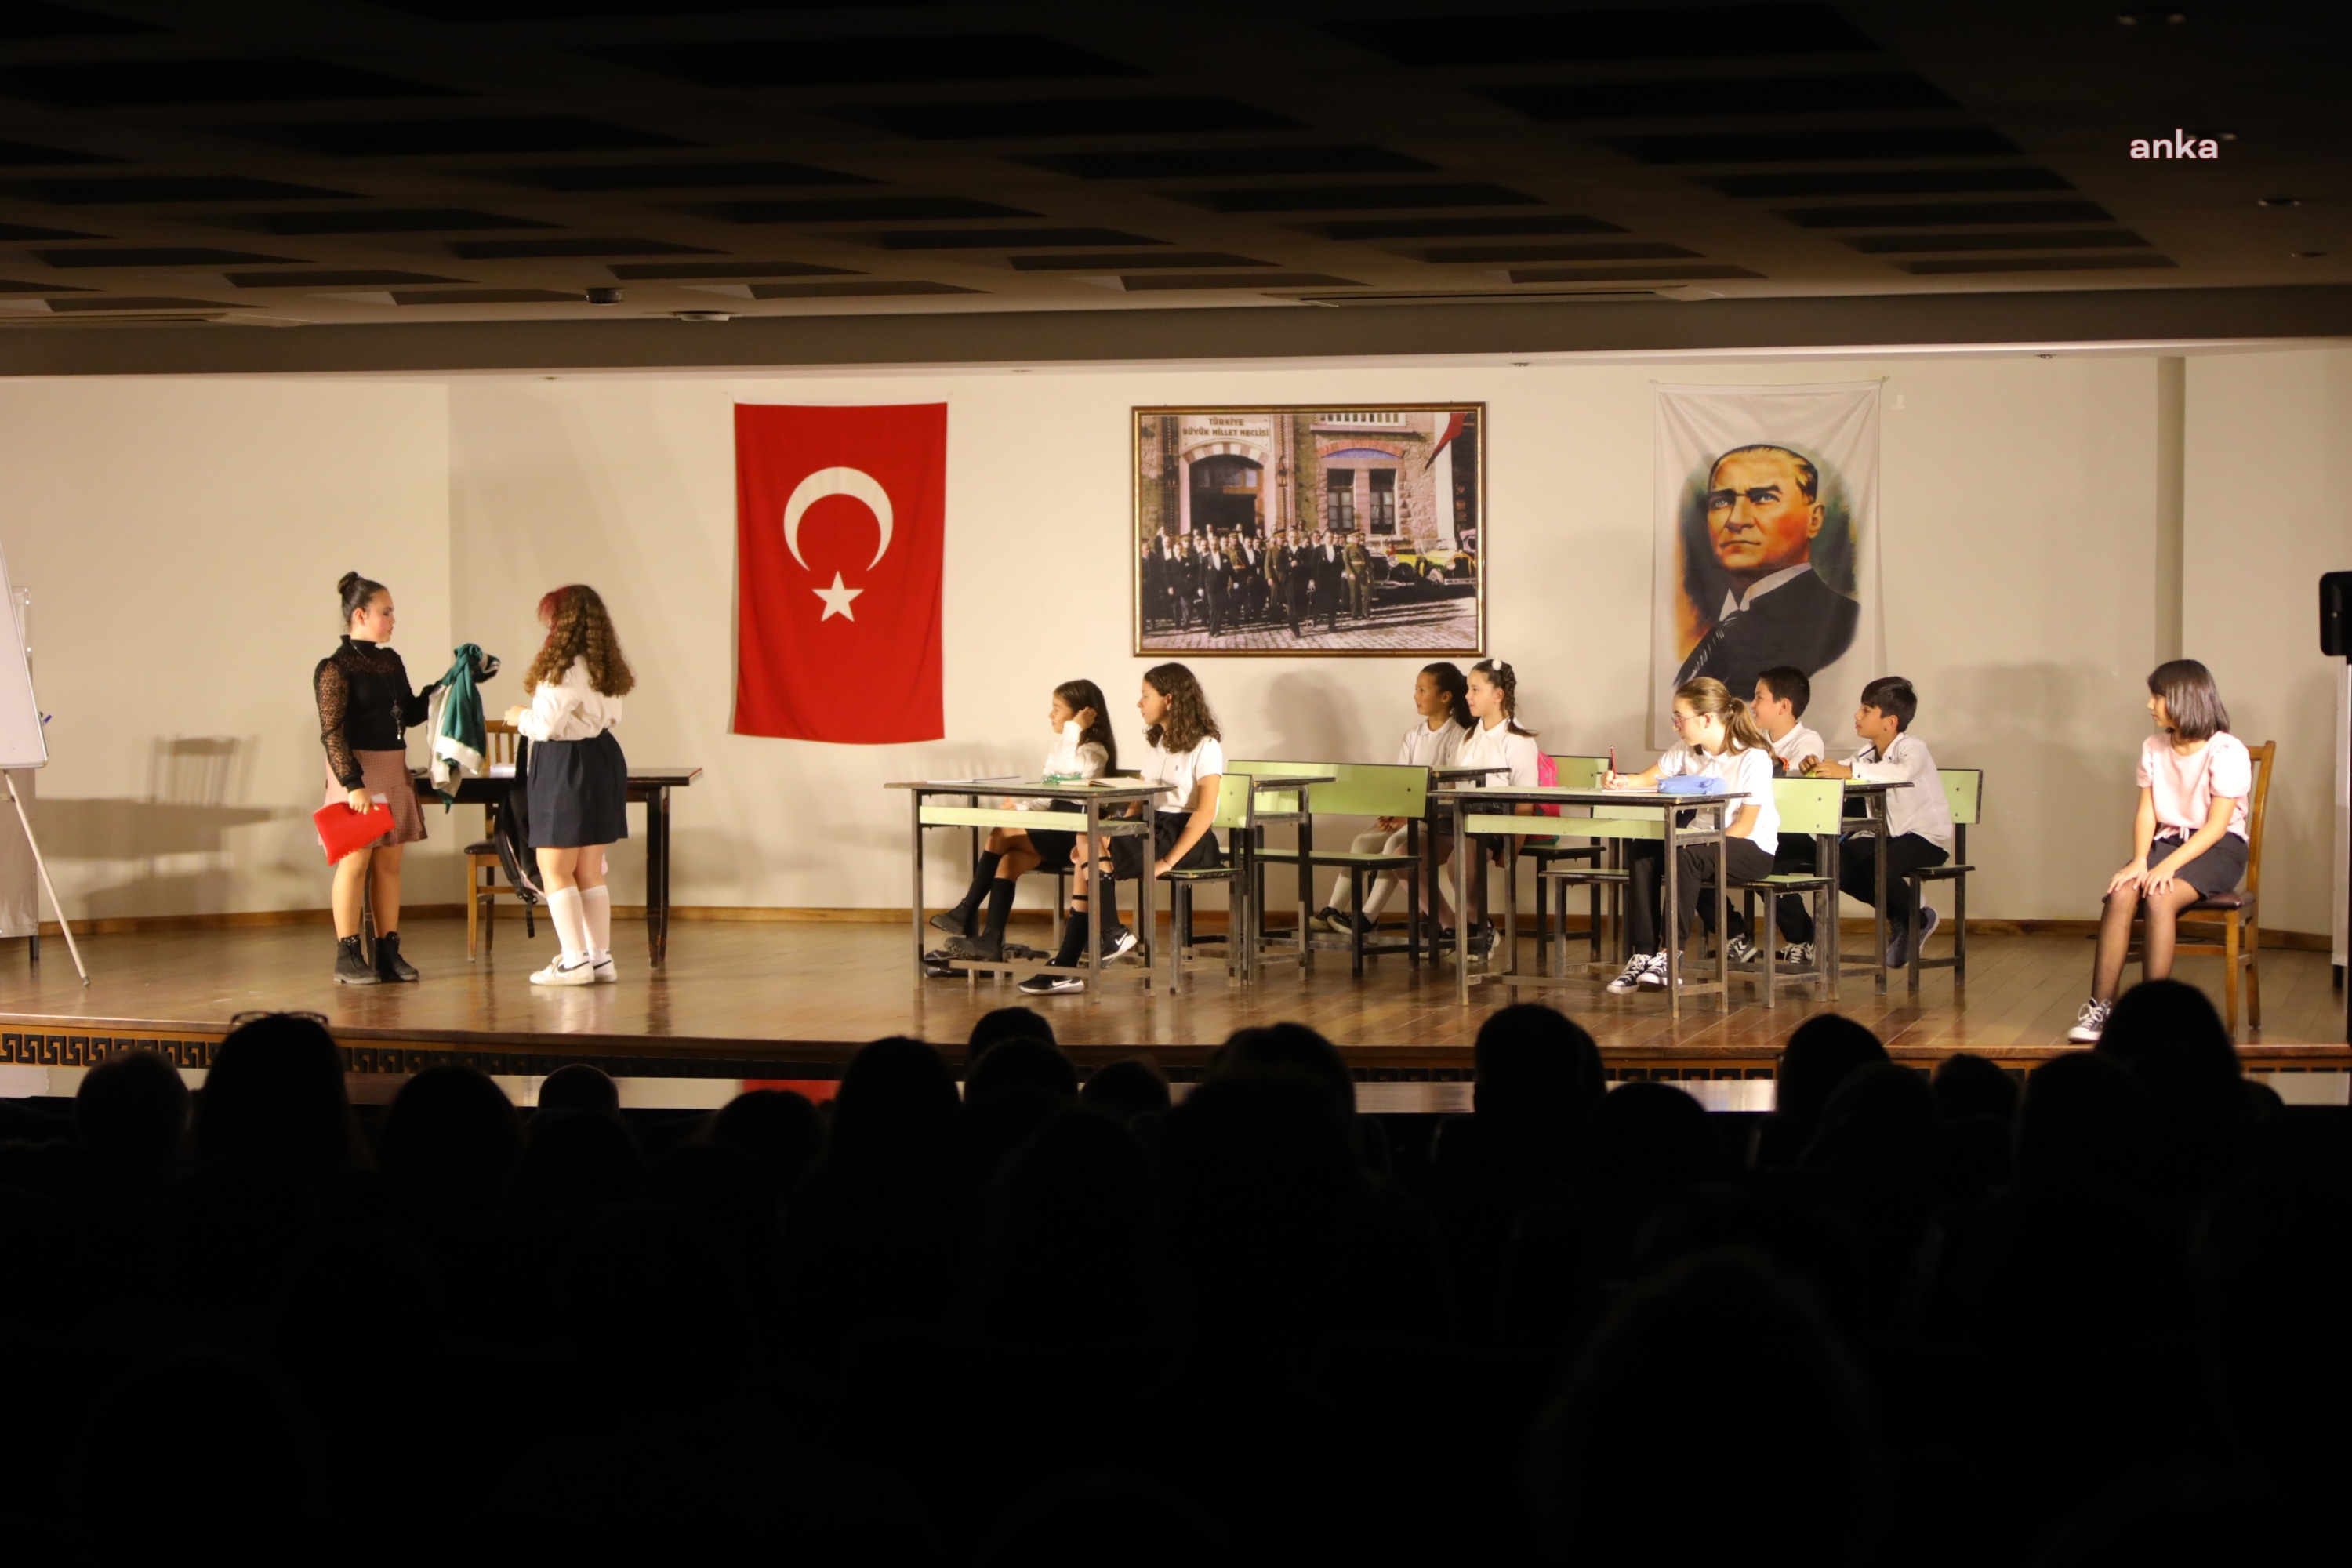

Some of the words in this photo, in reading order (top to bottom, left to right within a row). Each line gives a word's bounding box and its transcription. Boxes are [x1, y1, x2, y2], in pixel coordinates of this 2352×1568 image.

[1208, 416, 1244, 426] TÜRKİYE
[1182, 426, 1209, 435] BÜYÜK
[1212, 427, 1238, 436] MİLLET
[1240, 427, 1269, 437] MECLİSİ
